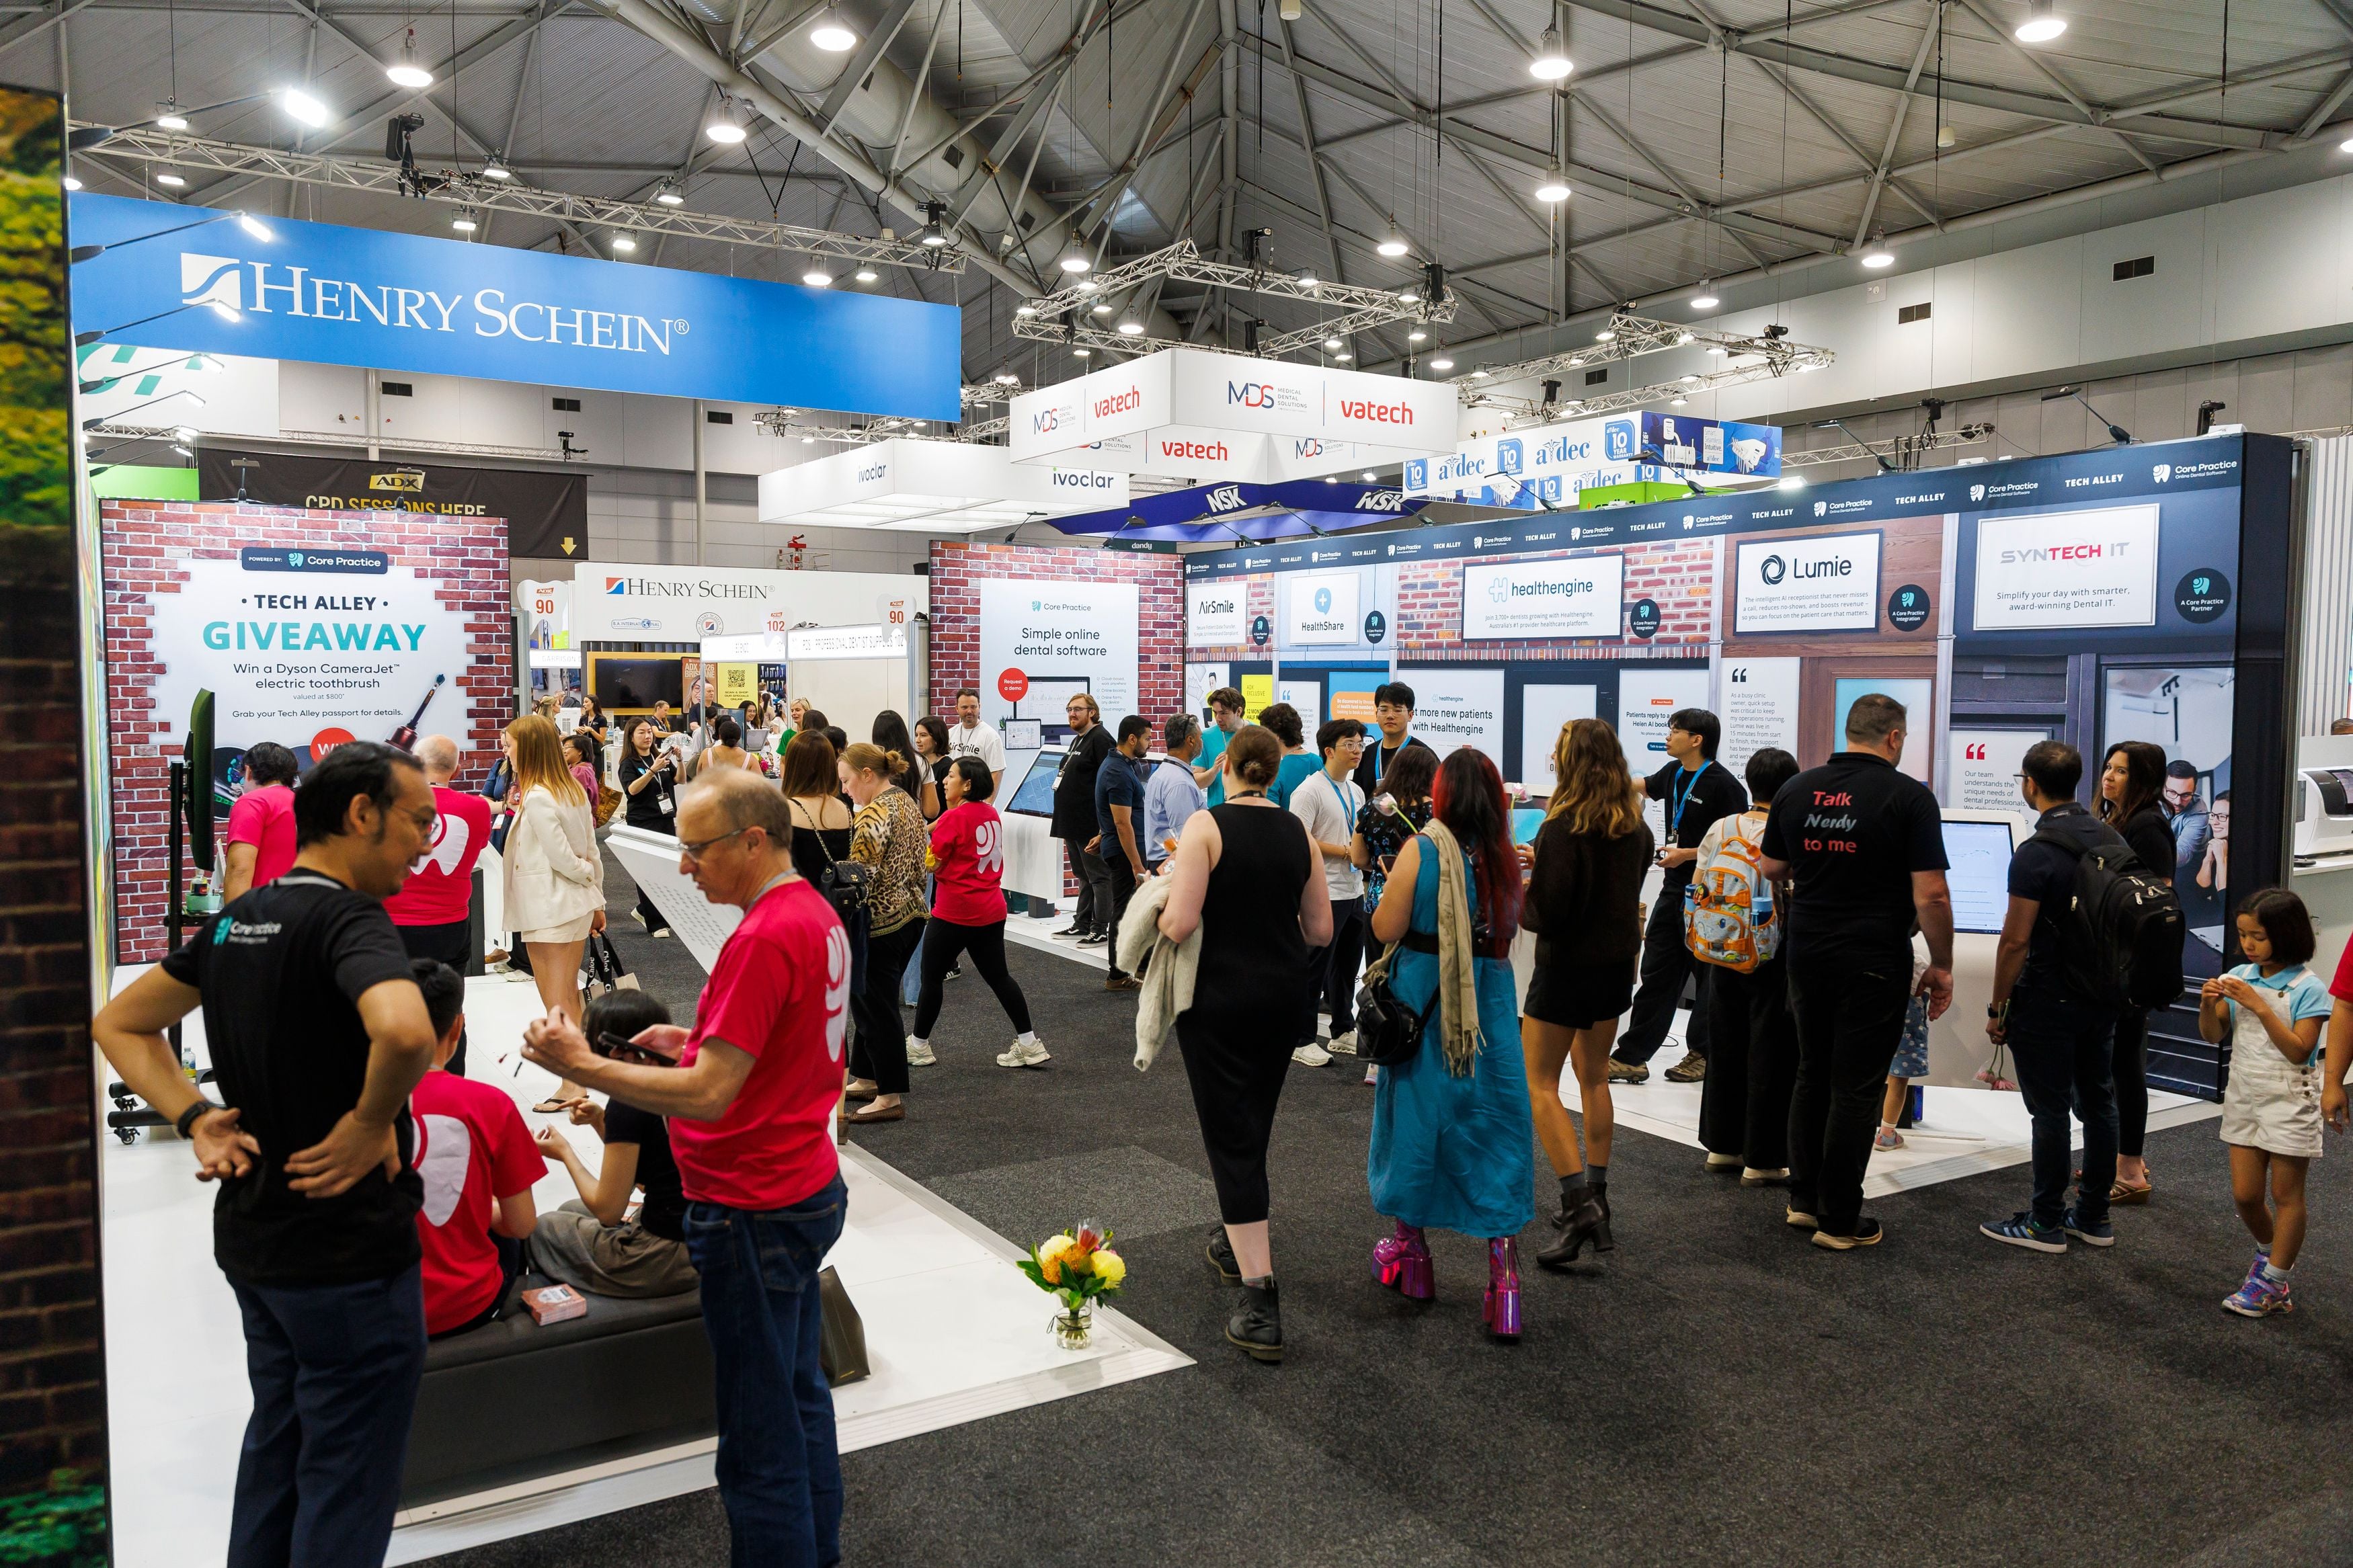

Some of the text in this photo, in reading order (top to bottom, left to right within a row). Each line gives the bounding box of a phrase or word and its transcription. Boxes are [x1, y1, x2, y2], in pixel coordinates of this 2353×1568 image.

[1095, 385, 1140, 418] vatech
[1229, 380, 1274, 409] MDS
[1277, 401, 1307, 409] SOLUTIONS
[1341, 401, 1412, 425] vatech
[1035, 409, 1058, 435] MDS
[1612, 432, 1627, 448] 10
[1162, 442, 1228, 460] vatech
[2198, 460, 2237, 470] Practice
[859, 462, 886, 483] ivoclar
[1053, 467, 1113, 488] ivoclar
[1411, 466, 1422, 480] 10
[376, 476, 417, 489] ADX
[2007, 482, 2038, 491] Practice
[2065, 474, 2124, 487] TECH ALLEY
[1206, 485, 1247, 512] NSK
[1355, 491, 1413, 511] NSK
[1895, 493, 1945, 504] TECH ALLEY
[1752, 509, 1793, 519] TECH ALLEY
[2000, 542, 2130, 563] SYNTECH IT
[308, 556, 381, 567] Core Practice
[1794, 555, 1851, 578] Lumie
[1512, 579, 1593, 597] healthengine
[1997, 587, 2130, 600] Simplify your day with smarter,
[254, 595, 376, 610] TECH ALLEY
[536, 600, 554, 614] 90
[1199, 600, 1234, 614] AirSmile
[2009, 599, 2115, 611] award-winning Dental IT.
[889, 611, 904, 623] 90
[767, 621, 785, 631] 102
[1302, 621, 1344, 631] HealthShare
[203, 621, 426, 651] GIVEAWAY
[1022, 628, 1100, 641] Simple online
[1014, 645, 1107, 655] dental software
[233, 664, 259, 673] Win
[277, 664, 316, 675] Dyson
[255, 678, 380, 688] electric toothbrush
[300, 710, 319, 718] Alley
[1460, 709, 1492, 720] patients
[1412, 722, 1483, 735] with Healthengine
[1813, 792, 1852, 806] Talk
[1804, 814, 1857, 832] Nerdy
[1804, 838, 1857, 852] to me
